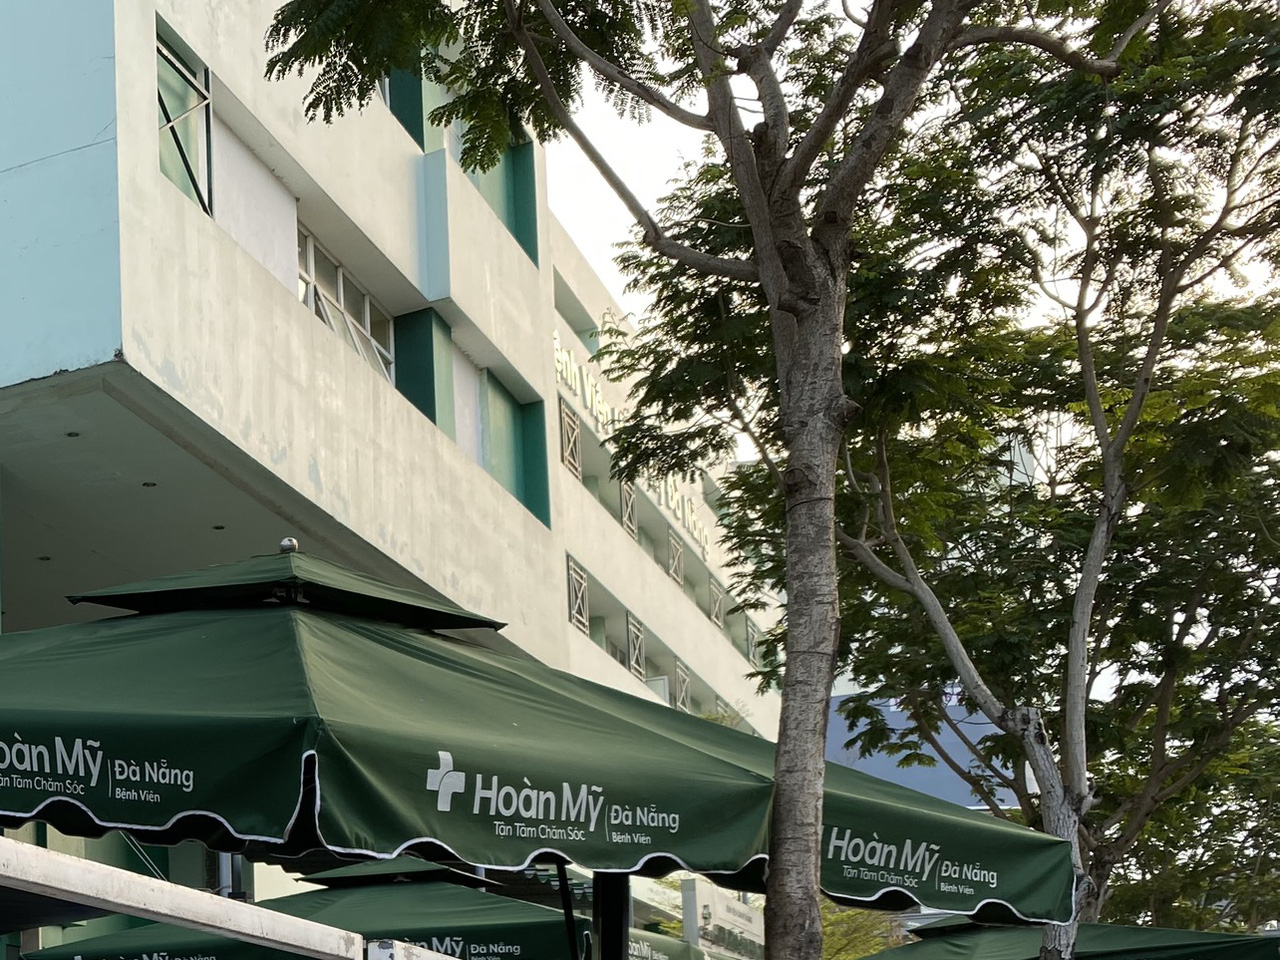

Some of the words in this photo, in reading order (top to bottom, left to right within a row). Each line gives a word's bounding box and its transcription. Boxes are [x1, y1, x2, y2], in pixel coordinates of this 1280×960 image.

[55, 736, 104, 787] Mỹ
[114, 759, 141, 782] Đà
[145, 758, 194, 793] Nẵng
[13, 774, 33, 790] Tâm
[34, 776, 64, 793] Chăm
[65, 780, 86, 796] Sóc
[115, 787, 138, 802] Bệnh
[139, 789, 161, 804] Viện
[472, 773, 556, 821] Hoàn
[560, 781, 605, 832] Mỹ
[514, 822, 537, 839] Tâm
[538, 823, 567, 840] Chăm
[567, 825, 587, 842] Sóc
[609, 804, 633, 826] Đà
[636, 803, 680, 834] Nẵng
[827, 826, 898, 869] Hoàn
[899, 838, 941, 882] Mỹ
[941, 860, 960, 878] Đà
[962, 862, 998, 888] Nẵng
[470, 943, 487, 954] Đà
